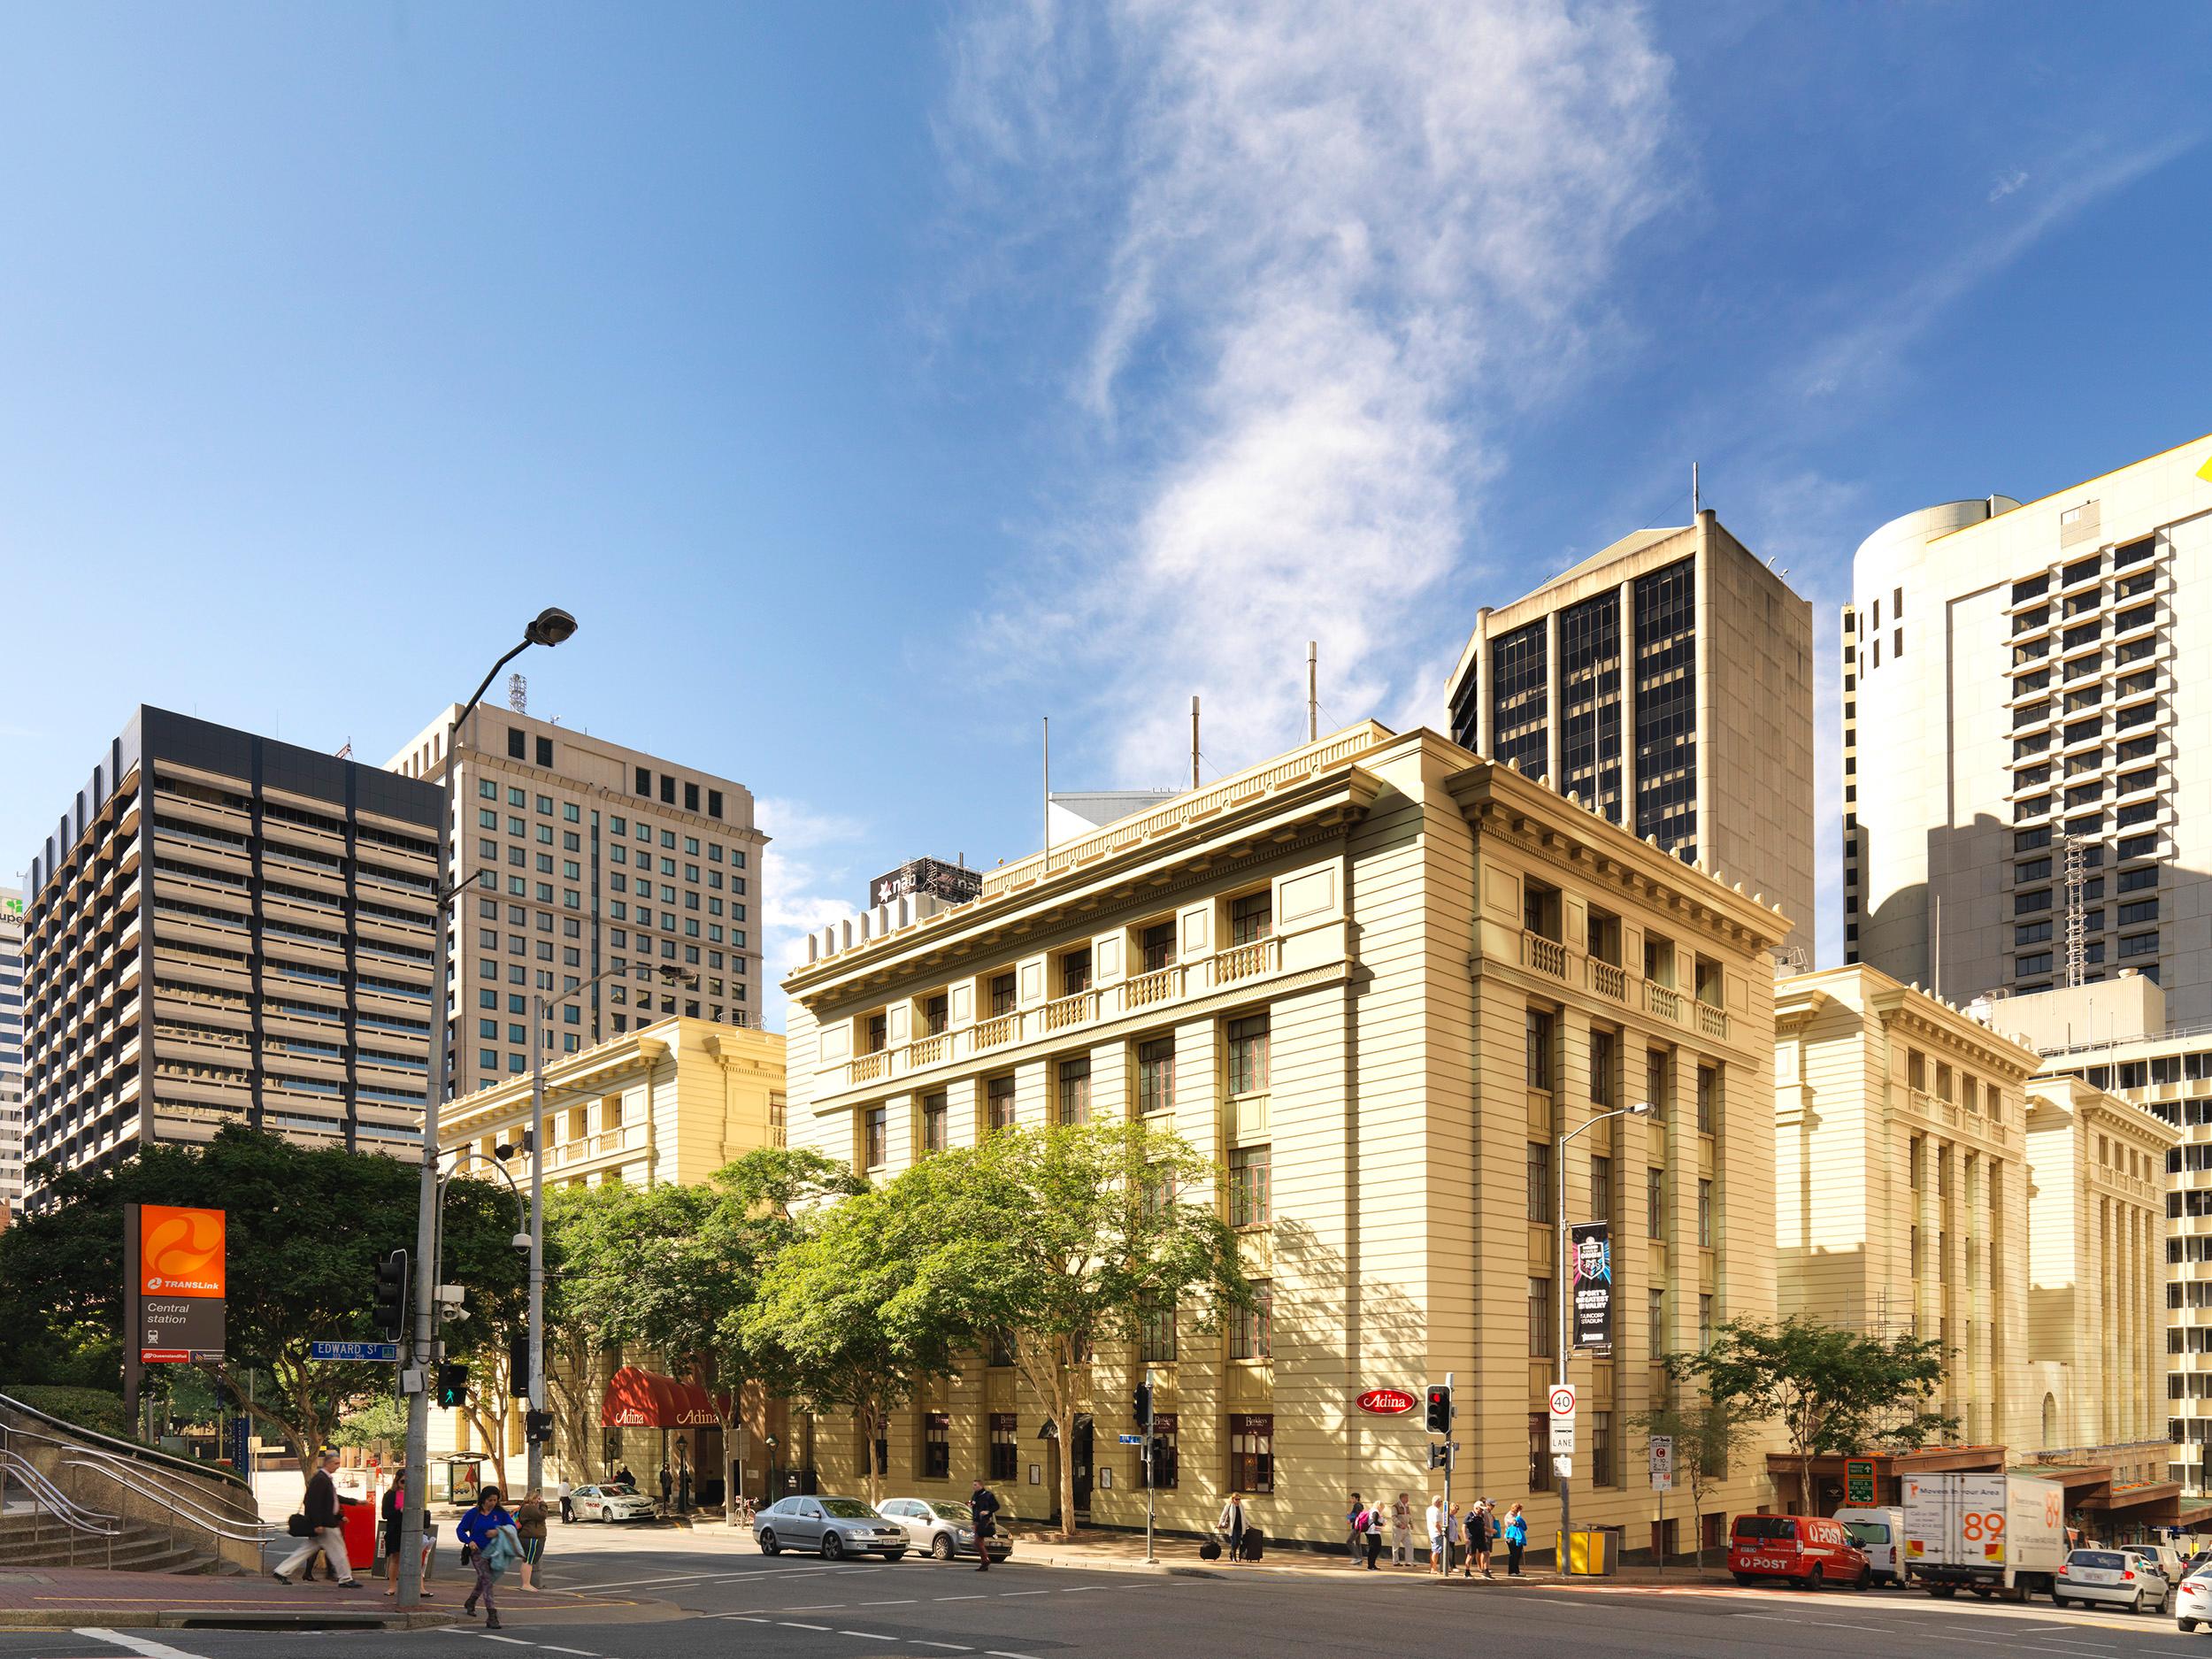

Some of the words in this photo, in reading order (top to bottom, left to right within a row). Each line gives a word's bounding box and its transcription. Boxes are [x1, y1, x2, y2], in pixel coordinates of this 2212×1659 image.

[165, 1280, 219, 1290] TRANSLink
[147, 1302, 190, 1313] Central
[147, 1315, 187, 1324] station
[319, 1343, 361, 1355] EDWARD
[367, 1344, 378, 1355] ST
[1363, 1394, 1406, 1409] Adina
[1554, 1396, 1571, 1408] 40
[615, 1409, 644, 1425] Adina
[676, 1409, 718, 1425] Adina
[1553, 1439, 1572, 1448] LANE
[1962, 1512, 2006, 1541] 89
[1817, 1526, 1842, 1545] POST
[1752, 1558, 1788, 1570] POST
